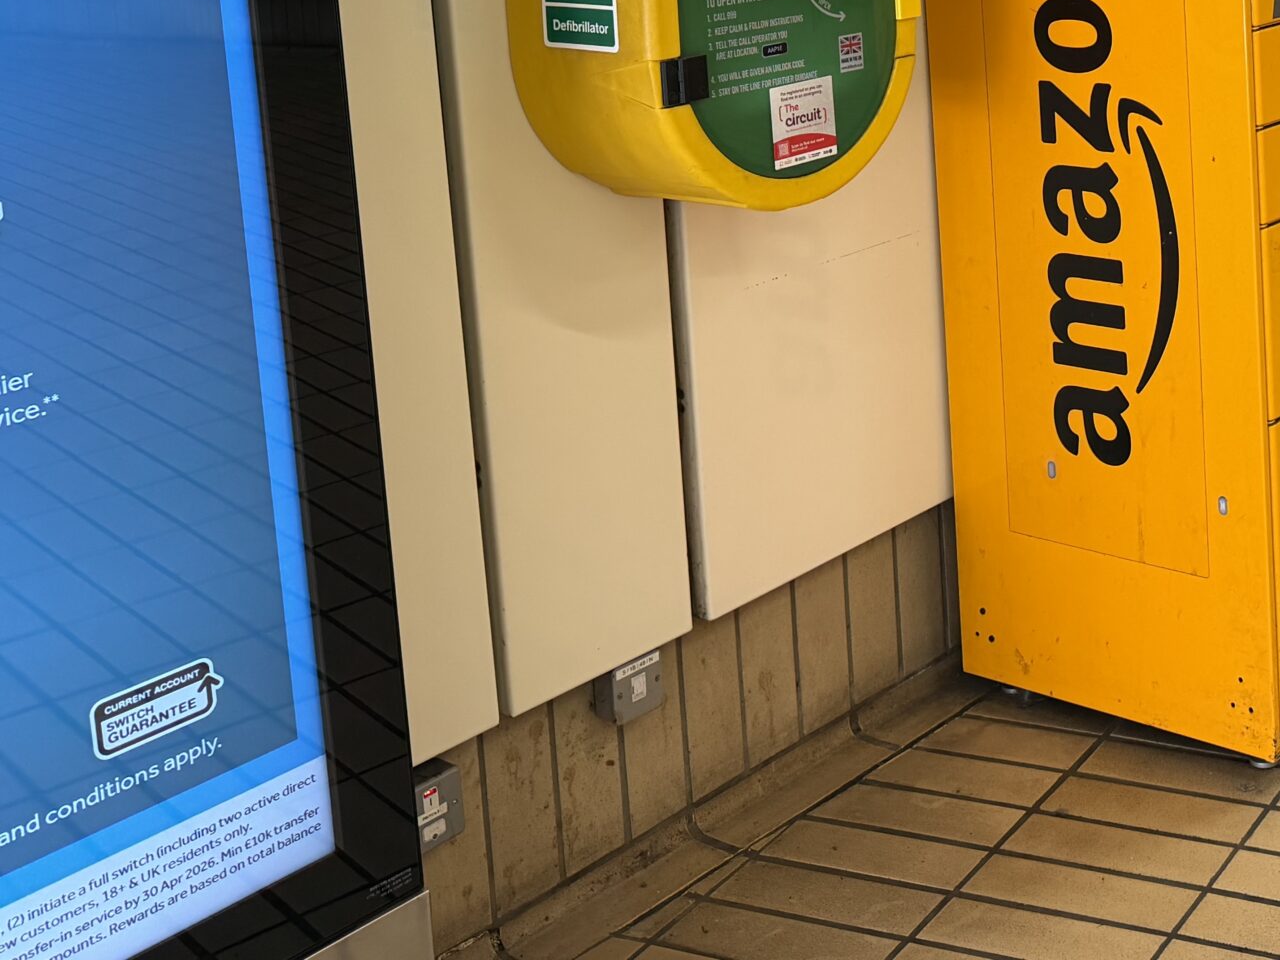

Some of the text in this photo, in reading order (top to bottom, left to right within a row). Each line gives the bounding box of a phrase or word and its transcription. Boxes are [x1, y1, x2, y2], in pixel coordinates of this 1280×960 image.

[552, 18, 609, 35] Defibrillator
[714, 12, 726, 22] CALL
[715, 26, 729, 36] KEEP
[729, 24, 744, 34] CALM
[749, 20, 770, 31] FOLLOW
[770, 15, 804, 27] INSTRUCTIONS
[716, 40, 728, 50] TELL
[729, 39, 738, 48] THE
[739, 37, 752, 46] CALL
[752, 32, 778, 44] OPERATOR
[779, 31, 788, 40] YOU
[716, 51, 726, 61] ARE
[727, 50, 734, 59] AT
[718, 74, 729, 83] YOU
[729, 72, 742, 82] WILL
[742, 70, 750, 79] BE
[750, 67, 765, 78] GIVEN
[719, 87, 731, 97] STAY
[732, 85, 739, 94] ON
[740, 84, 750, 93] THE
[750, 81, 761, 91] LINE
[762, 80, 772, 88] FOR
[785, 104, 800, 114] The
[786, 108, 822, 127] circuit
[0, 372, 33, 394] ier
[104, 669, 200, 715] CURRENT ACCOUNT
[106, 705, 154, 732] SWITCH
[108, 697, 197, 744] GUARANTEE
[45, 764, 160, 824] conditions
[164, 737, 222, 771] apply.
[8, 774, 317, 931] (2) initiate a full switch (including two active direct
[75, 906, 123, 936] service
[125, 896, 141, 910] by
[143, 886, 159, 902] 30
[161, 873, 184, 892] Apr
[186, 857, 220, 881] 2026.
[221, 845, 243, 863] Min
[245, 829, 274, 851] £10k
[274, 806, 321, 837] transfer
[110, 900, 165, 936] Rewards
[168, 887, 188, 904] are
[190, 868, 228, 891] based
[230, 861, 246, 875] on
[247, 843, 276, 866] total
[278, 822, 322, 851] balance
[0, 823, 253, 954] ew customers, 18+ & UK residents only.
